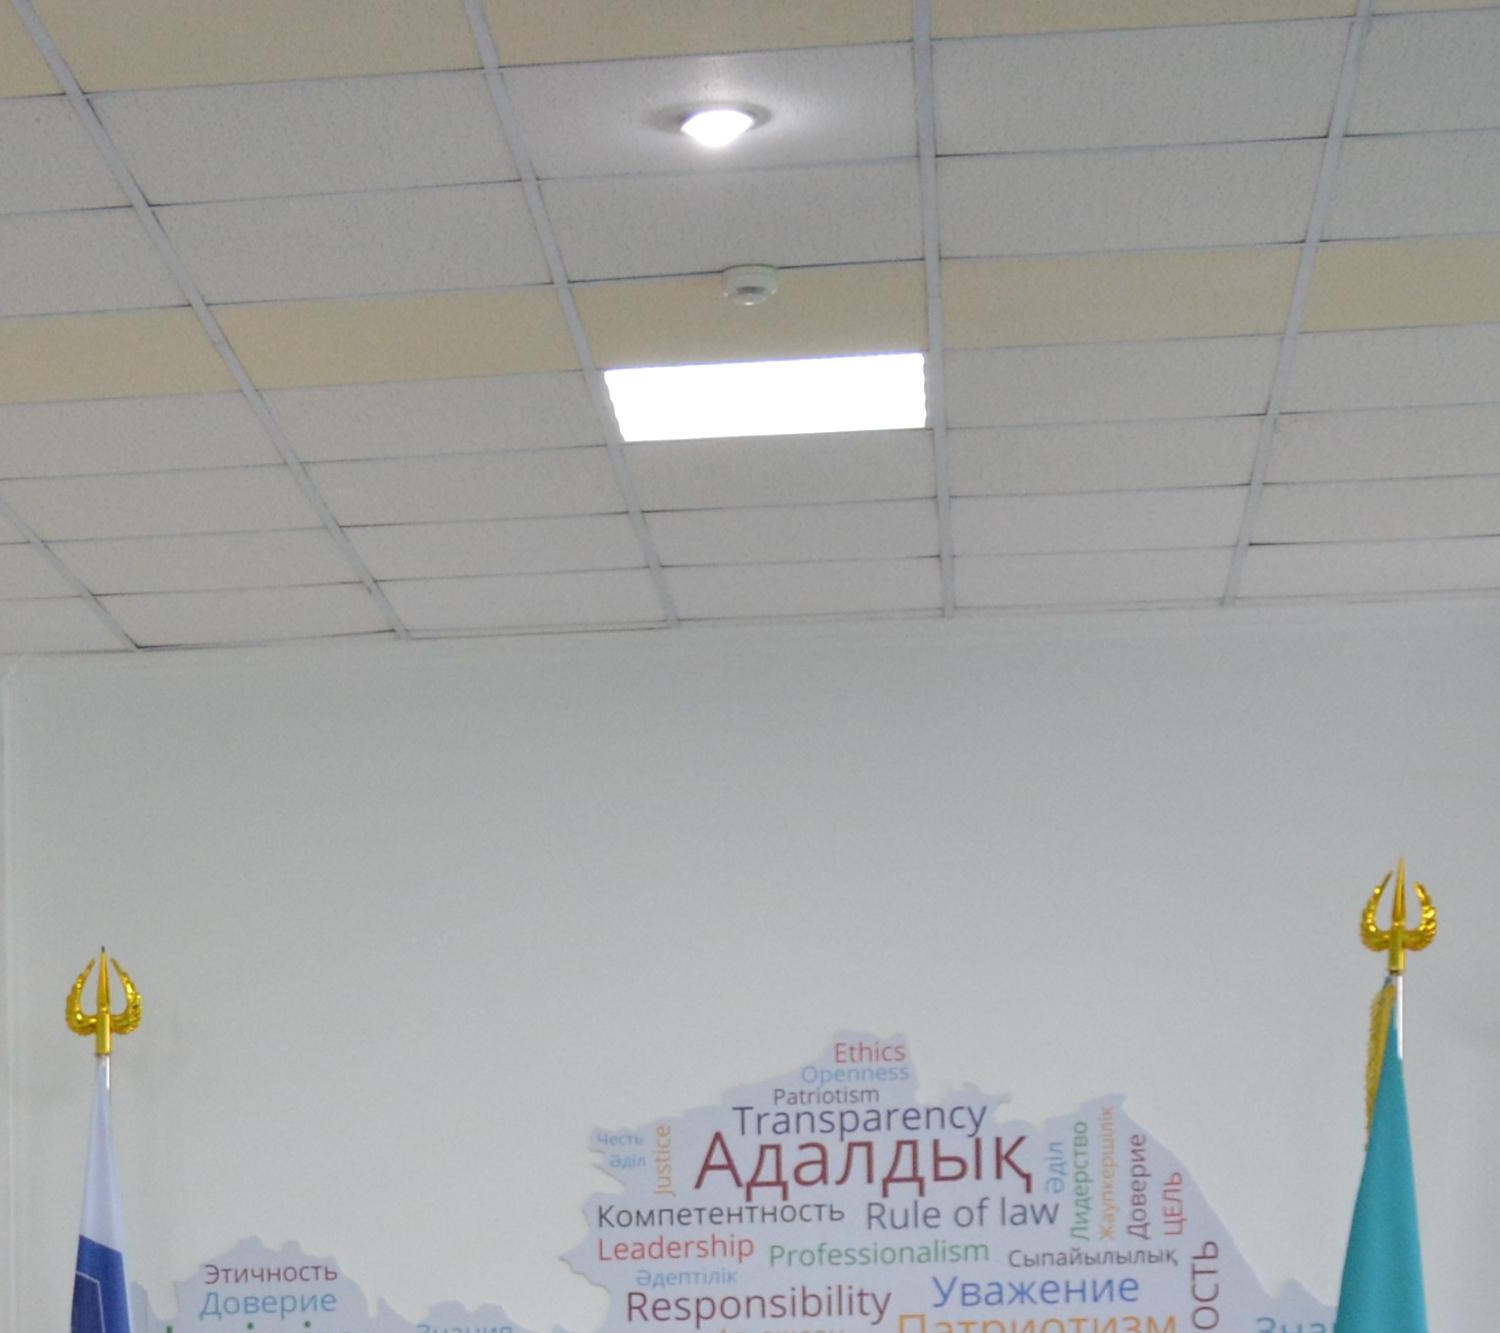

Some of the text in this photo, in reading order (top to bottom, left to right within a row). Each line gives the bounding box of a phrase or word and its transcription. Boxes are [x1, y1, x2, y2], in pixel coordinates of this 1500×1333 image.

[834, 1042, 906, 1063] Ethics
[800, 1065, 910, 1088] Openness
[773, 1087, 879, 1105] Patriotism
[732, 1102, 987, 1142] Transparency
[694, 1131, 1033, 1202] Адалдық
[1128, 1134, 1151, 1240] Доверие
[597, 1203, 846, 1229] Компетентность
[866, 1196, 1060, 1231] Rule of law
[1163, 1171, 1188, 1237] ЦЕЛЬ
[598, 1234, 755, 1264] Leadership
[769, 1240, 990, 1268] Professionalism
[204, 1264, 339, 1285] Этичность
[199, 1291, 338, 1320] Доверие
[931, 1276, 1141, 1308] Уважение
[627, 1285, 892, 1330] Responsibility
